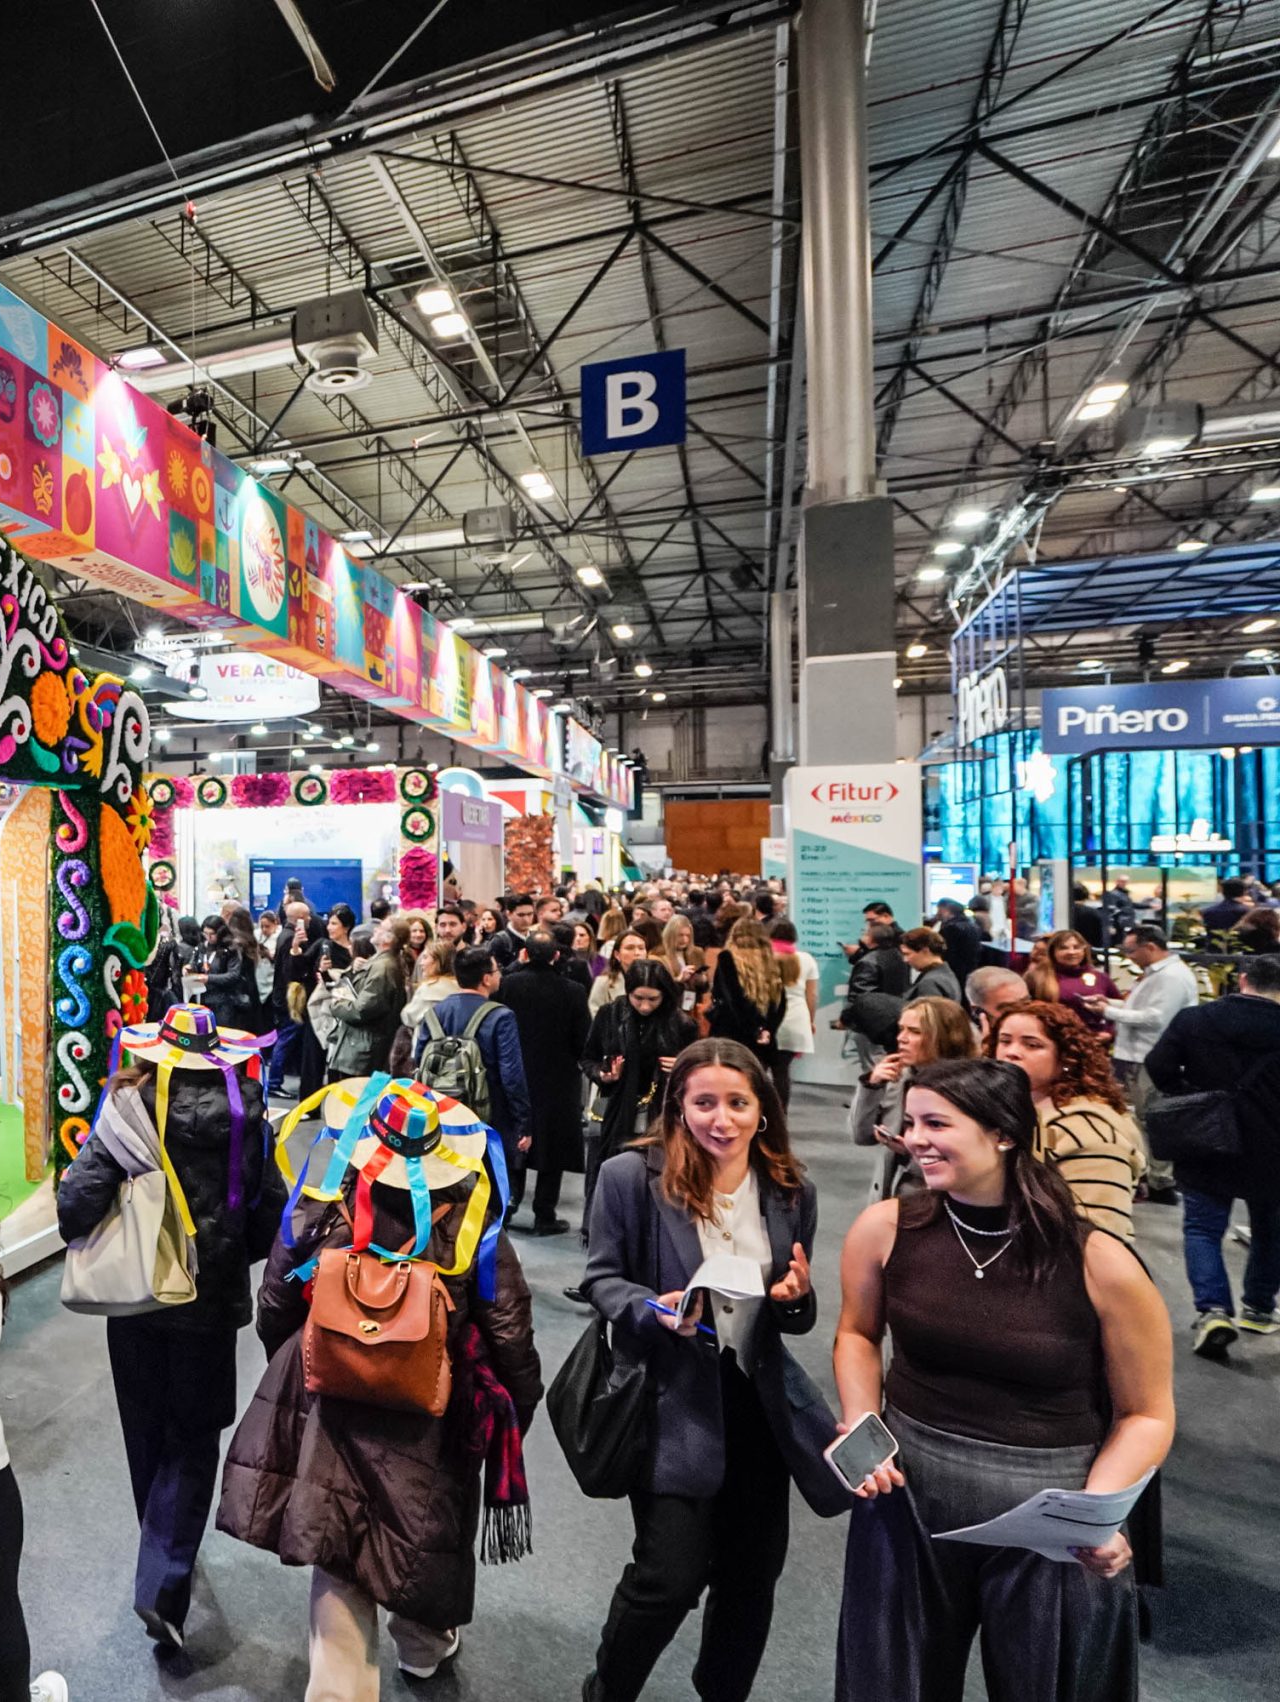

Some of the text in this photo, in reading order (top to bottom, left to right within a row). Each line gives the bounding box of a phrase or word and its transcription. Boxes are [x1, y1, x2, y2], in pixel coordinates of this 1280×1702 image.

[606, 371, 660, 440] B
[217, 663, 305, 681] VERACRUZ
[1057, 703, 1189, 736] Piñero
[828, 782, 884, 801] Fitur
[830, 811, 883, 823] MÉXICO
